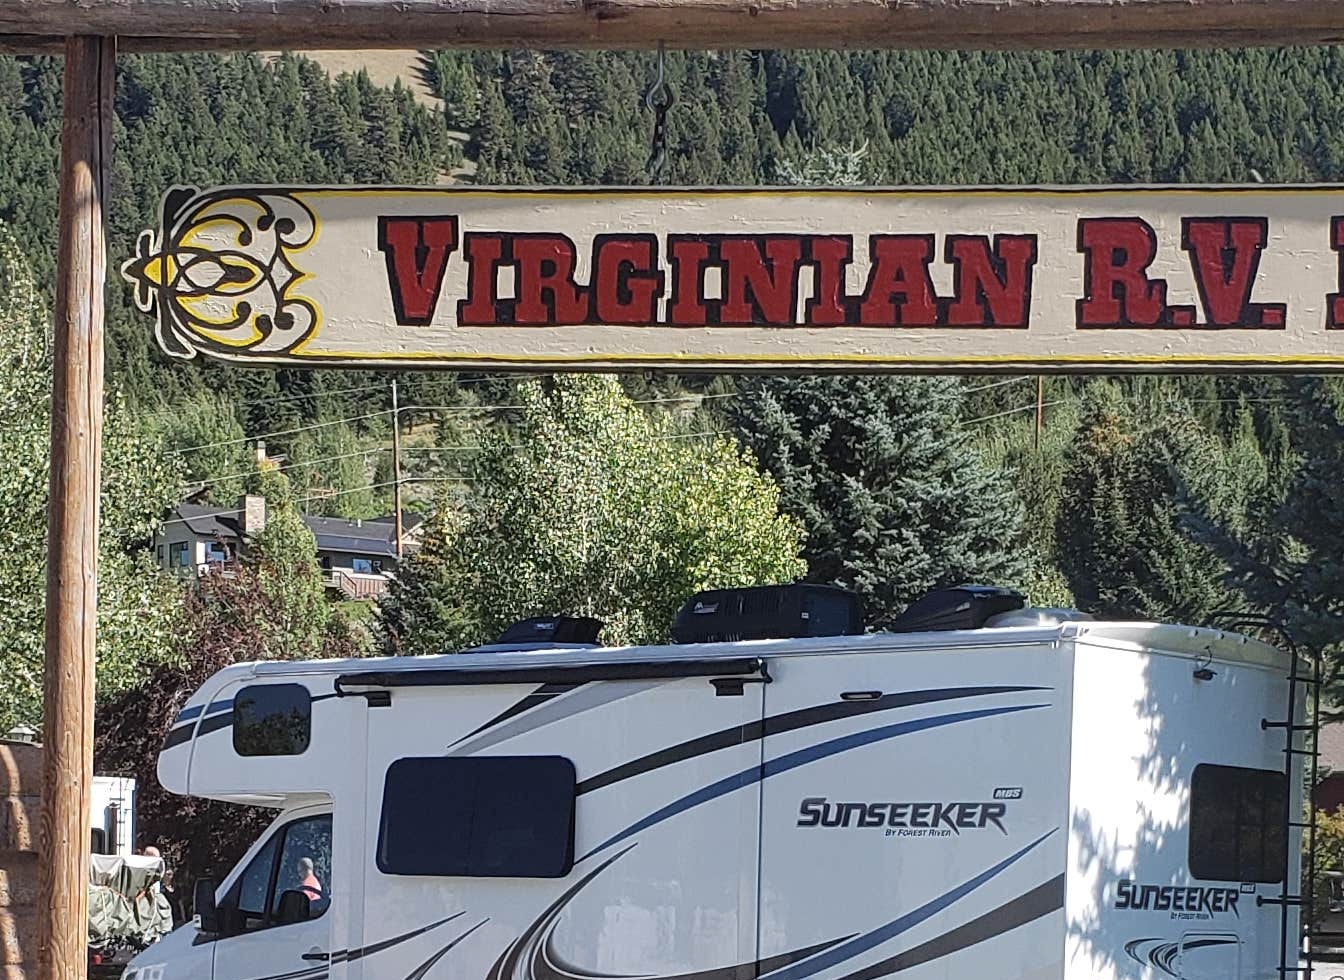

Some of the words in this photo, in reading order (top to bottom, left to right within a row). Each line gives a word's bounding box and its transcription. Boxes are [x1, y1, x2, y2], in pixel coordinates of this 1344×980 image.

[377, 214, 1038, 329] VIRGINIAN
[1076, 216, 1287, 330] R.V.
[796, 797, 1008, 836] SUNSEEKER
[1114, 879, 1240, 919] SUNSEEKER
